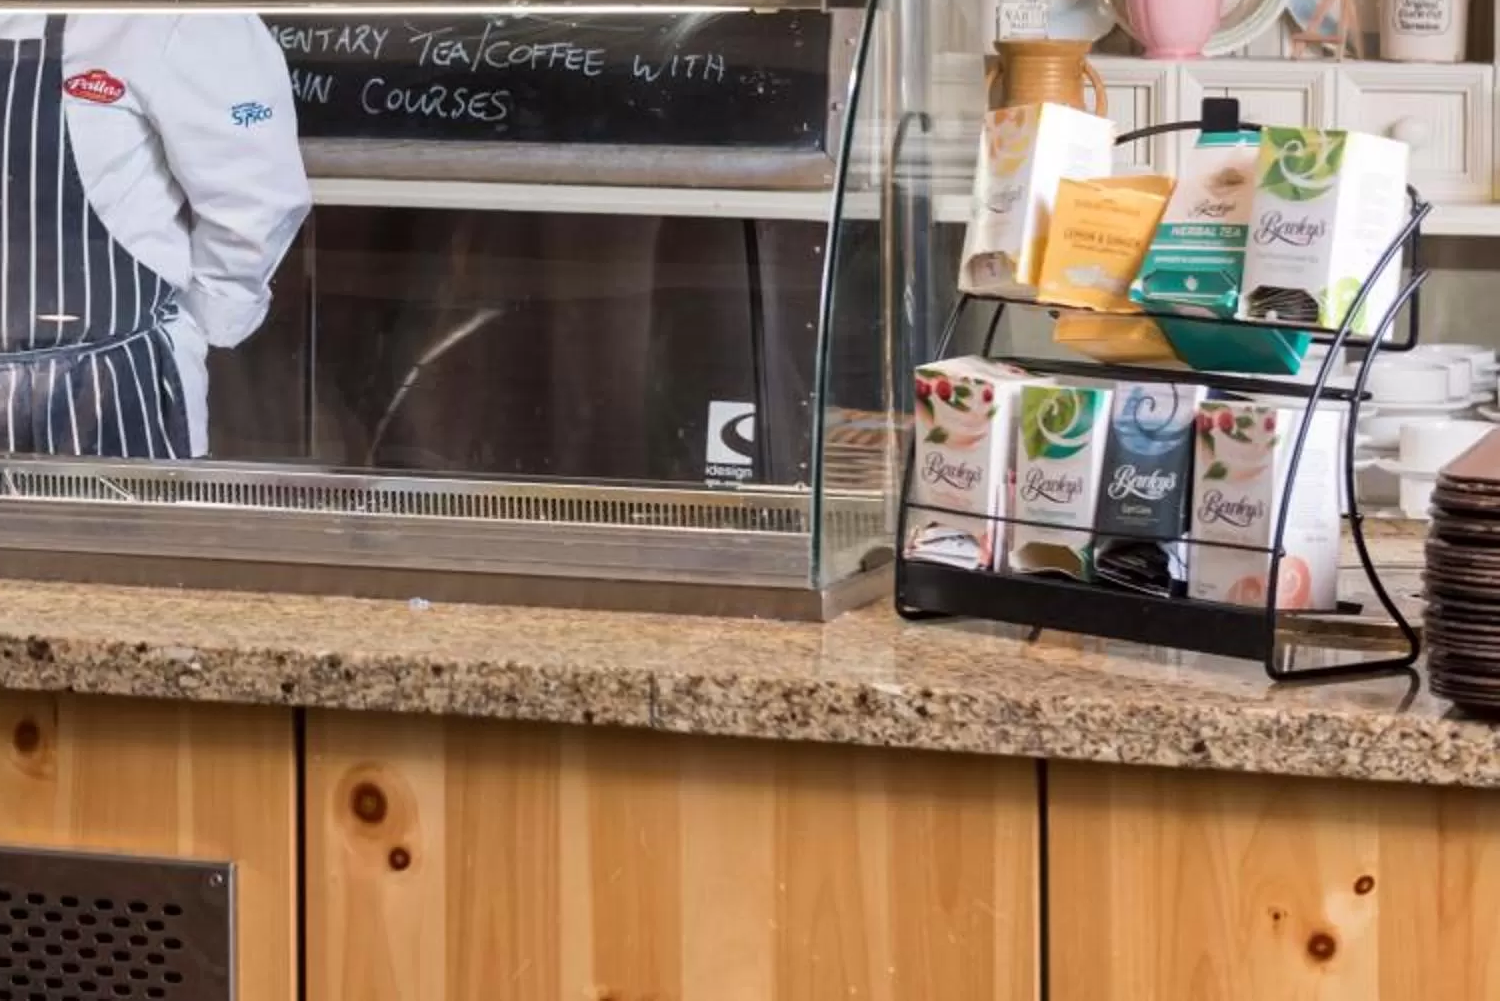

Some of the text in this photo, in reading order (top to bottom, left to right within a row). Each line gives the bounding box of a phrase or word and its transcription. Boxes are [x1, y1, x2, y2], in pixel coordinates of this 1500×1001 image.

[409, 23, 605, 77] TEA/COFFEE
[632, 52, 726, 83] WITH
[361, 77, 508, 121] COURSES
